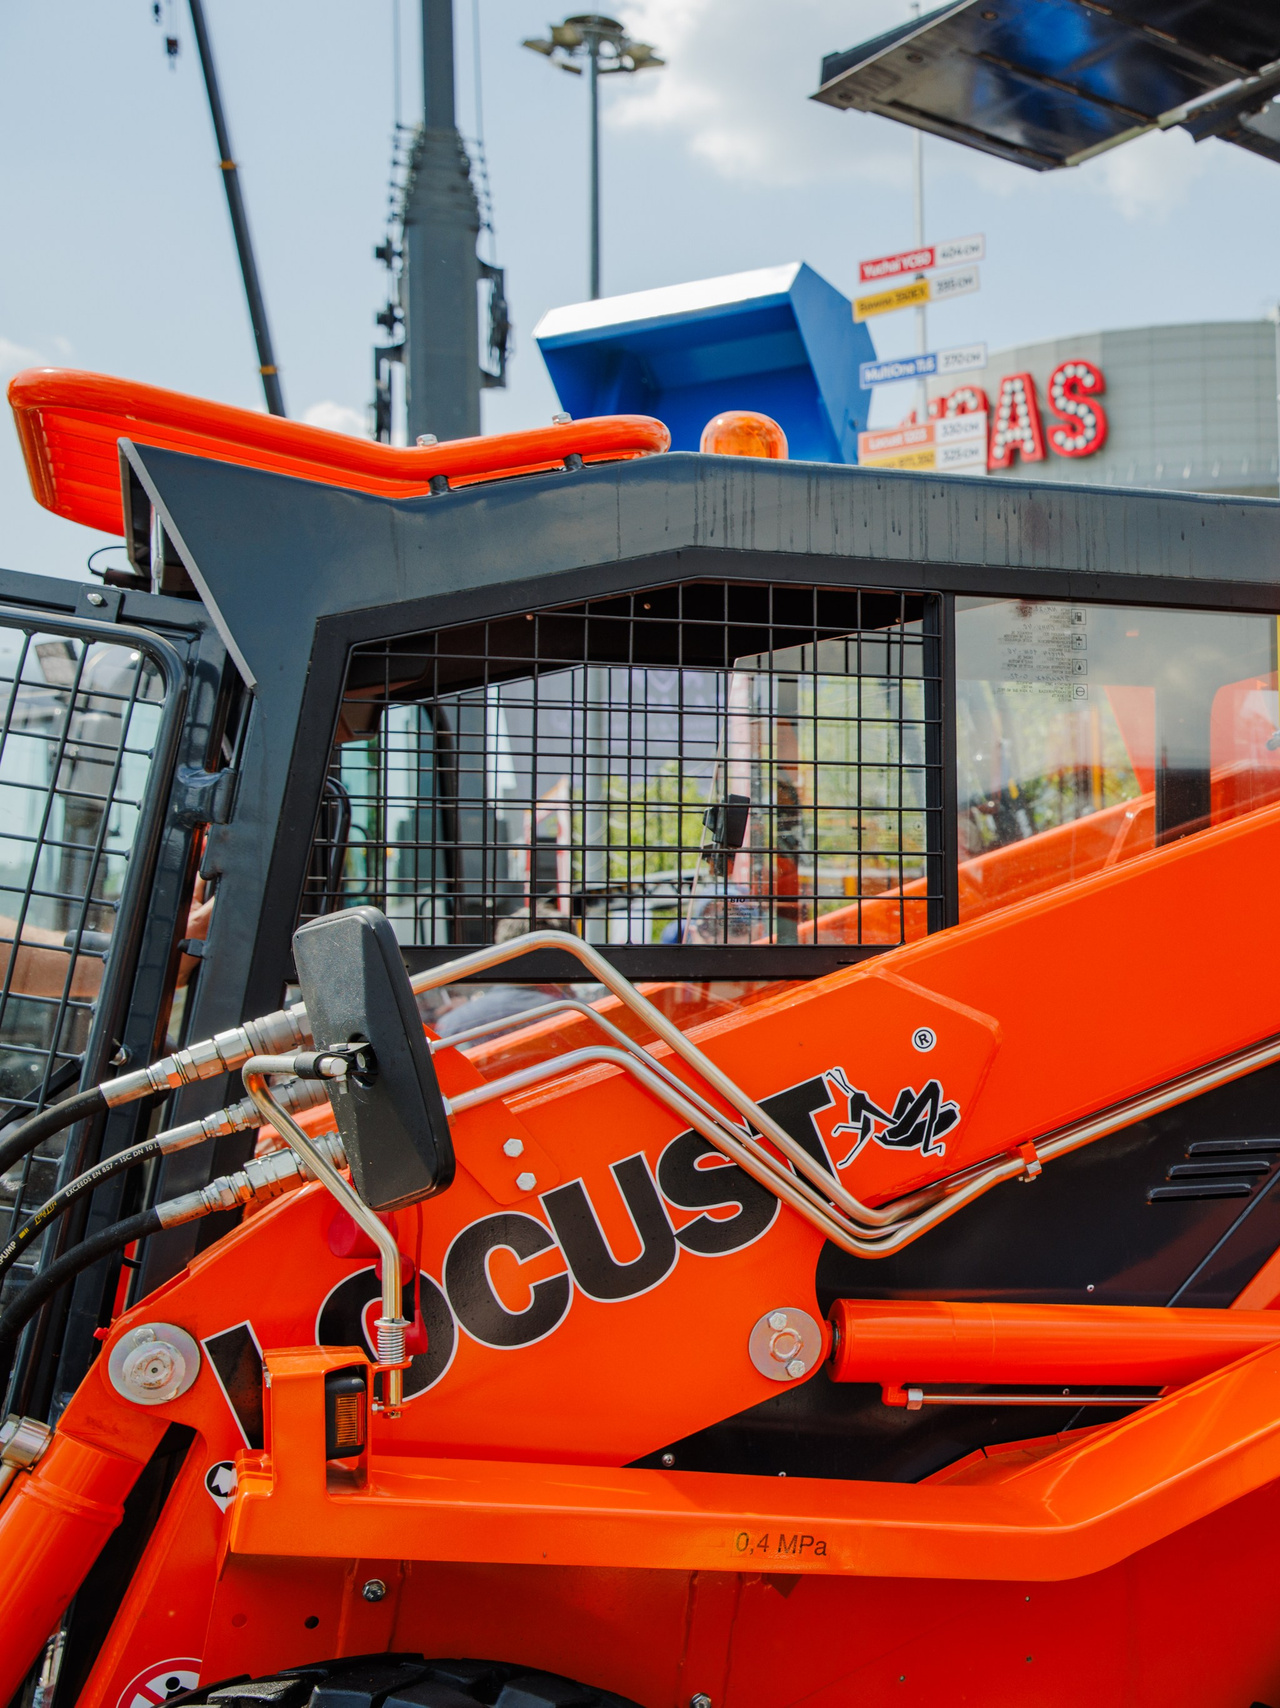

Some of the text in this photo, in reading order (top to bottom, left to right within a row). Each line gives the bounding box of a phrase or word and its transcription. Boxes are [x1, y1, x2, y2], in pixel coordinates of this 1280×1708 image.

[65, 1176, 92, 1198] EXCEEDS
[92, 1169, 102, 1179] EN
[133, 1149, 144, 1158] DN
[736, 1532, 827, 1556] 0,4 MPa
